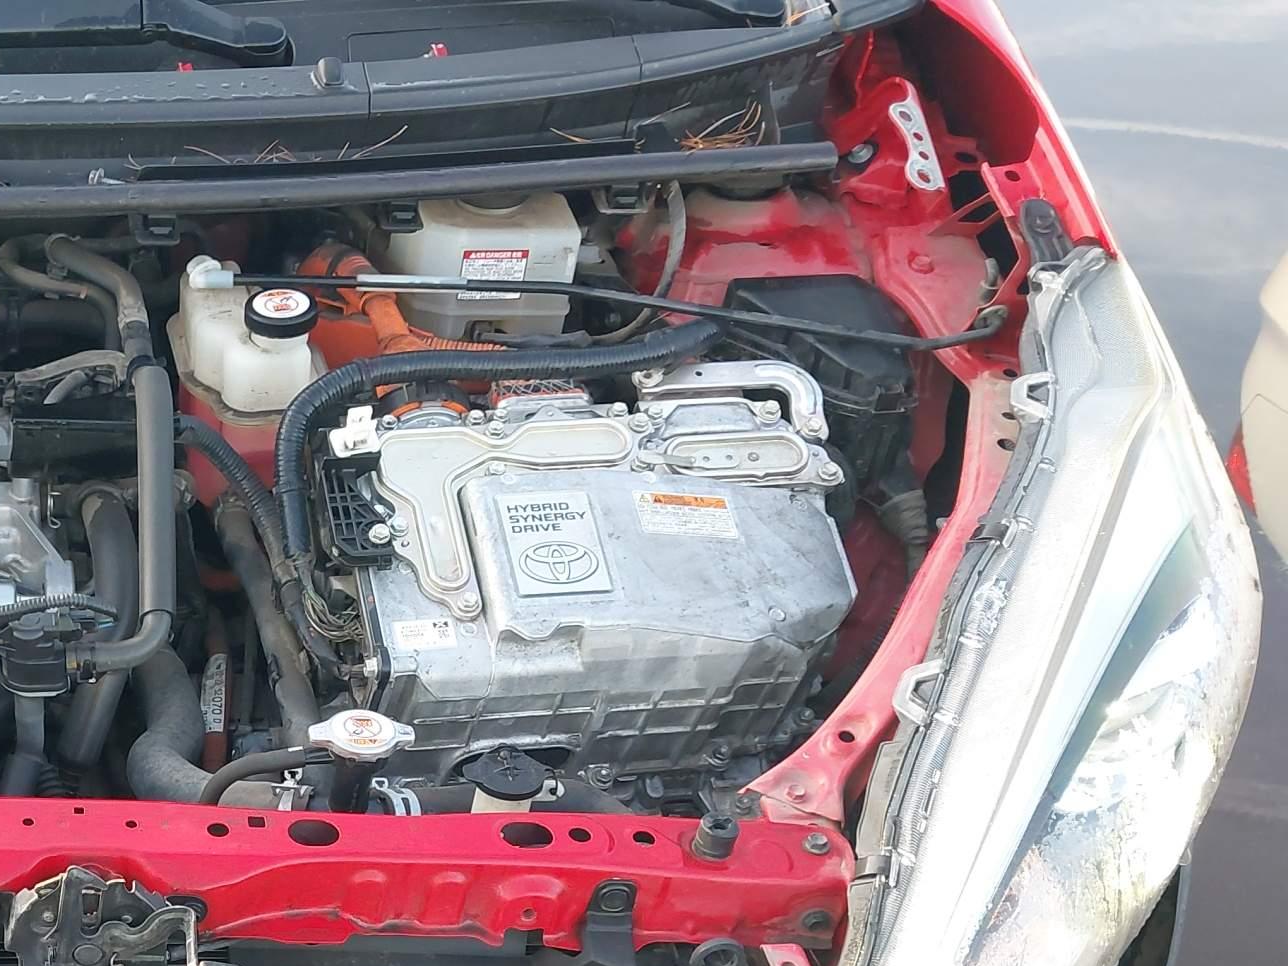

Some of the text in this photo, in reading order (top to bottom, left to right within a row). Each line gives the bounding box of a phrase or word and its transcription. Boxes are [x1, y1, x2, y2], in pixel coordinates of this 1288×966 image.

[507, 502, 569, 513] HYBRID
[509, 511, 586, 523] SYNERGY
[511, 523, 563, 534] DRIVE
